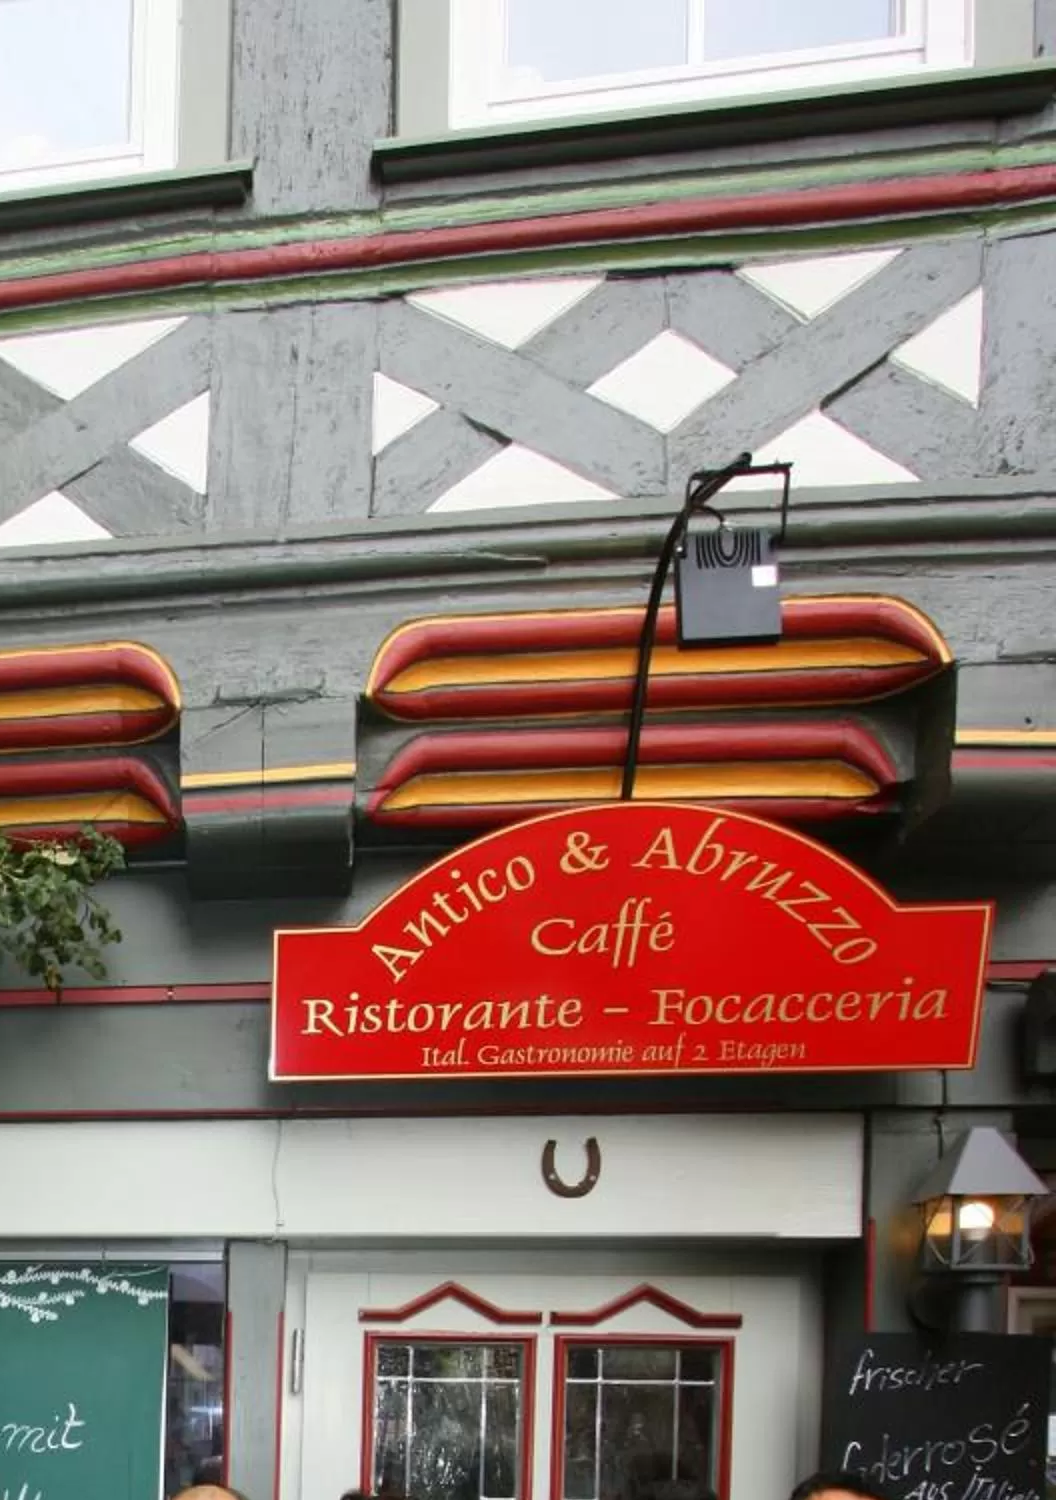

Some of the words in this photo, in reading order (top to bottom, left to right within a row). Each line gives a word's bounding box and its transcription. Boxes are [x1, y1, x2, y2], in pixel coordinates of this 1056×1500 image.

[371, 855, 536, 984] Antico
[559, 831, 610, 875] &
[630, 817, 878, 965] Abruzzo
[530, 897, 676, 969] Caffé
[300, 991, 584, 1037] Ristorante
[648, 976, 950, 1026] Focacceria
[420, 1037, 470, 1067] Ital.
[476, 1039, 634, 1067] Gastronomie
[641, 1031, 687, 1068] auf
[692, 1045, 710, 1062] 2
[716, 1039, 808, 1069] Etagen
[0, 1402, 86, 1453] mit
